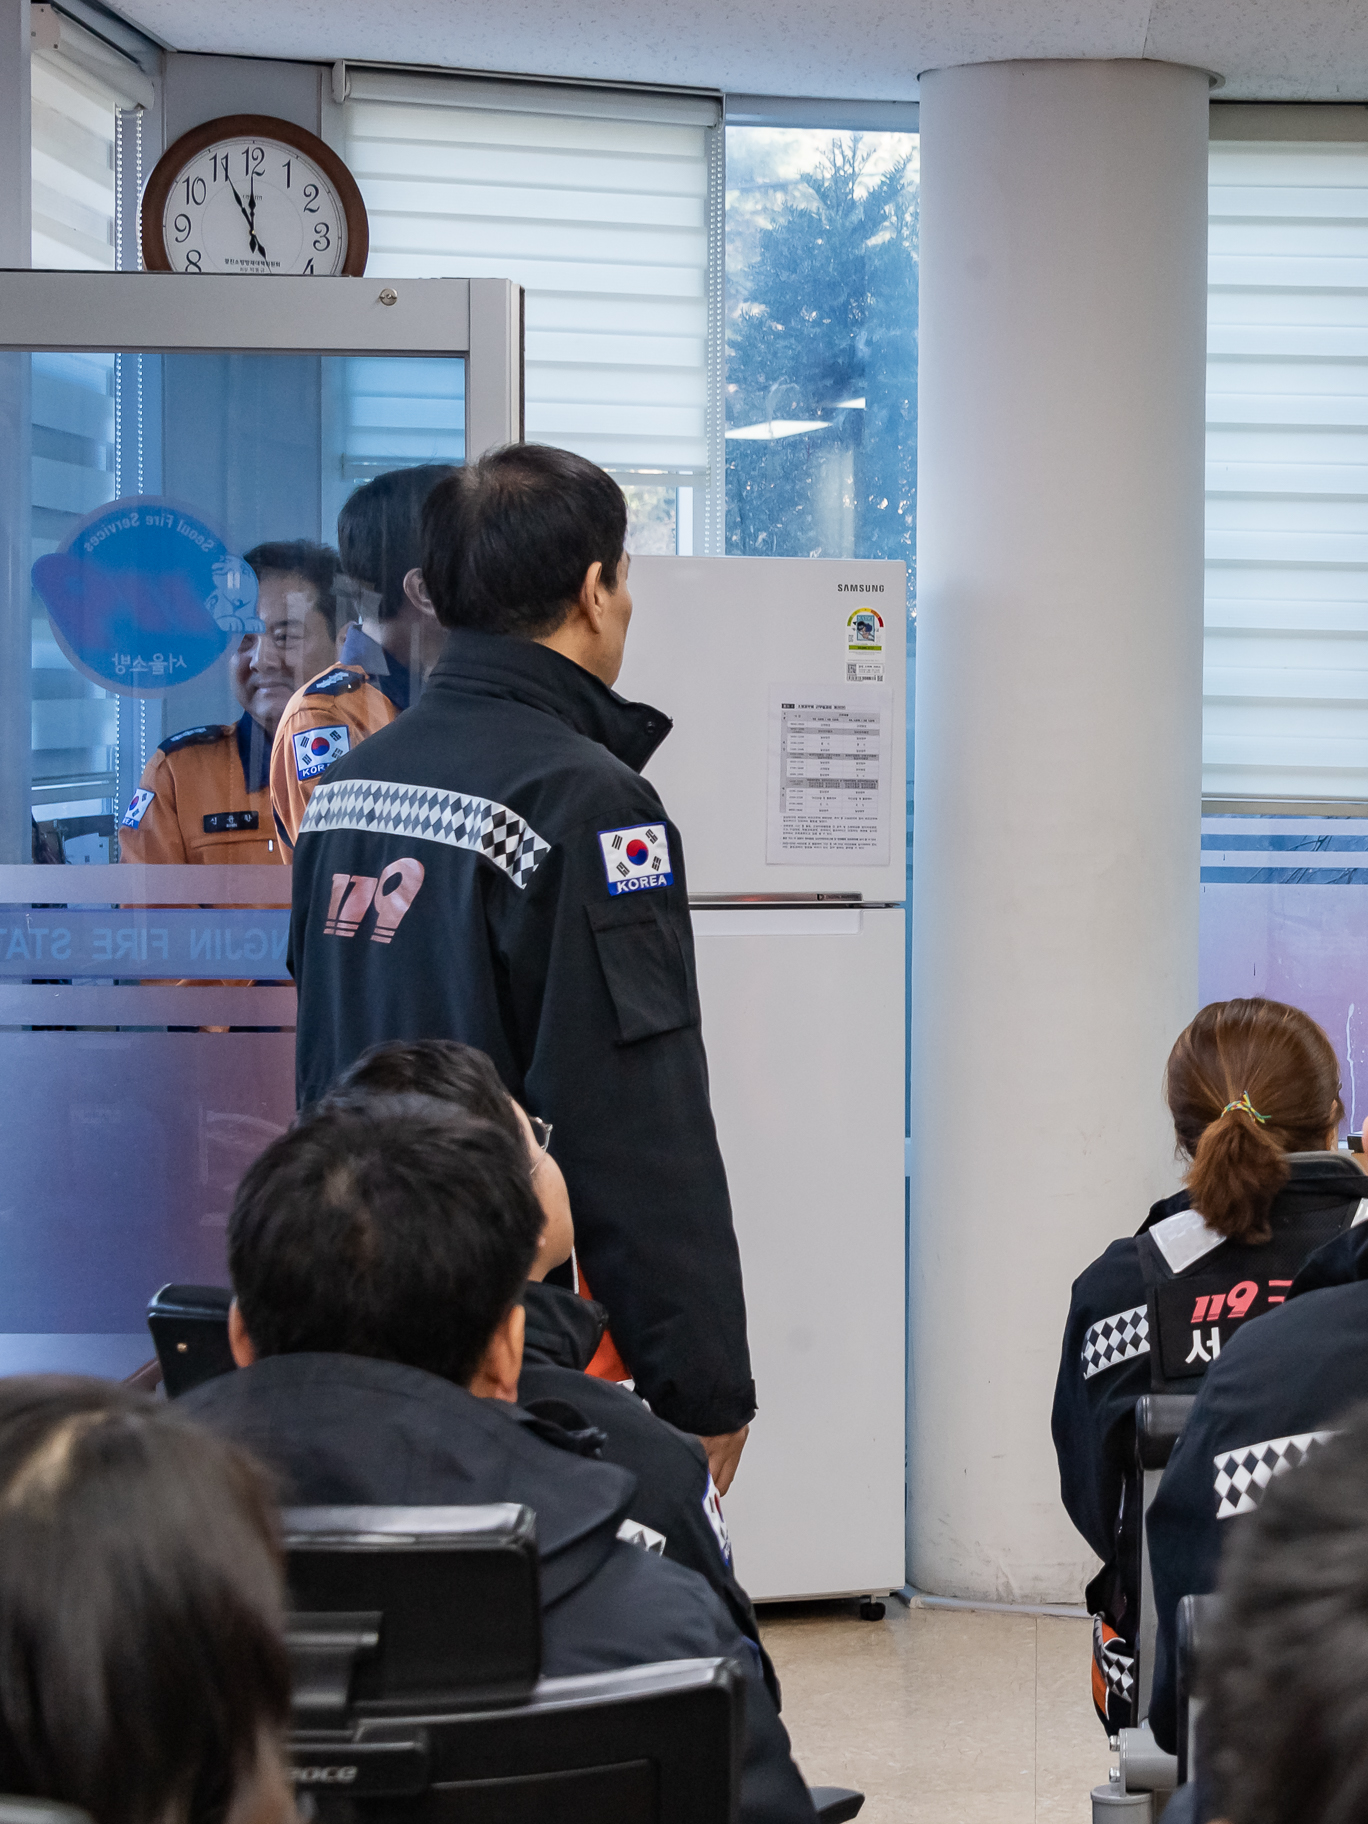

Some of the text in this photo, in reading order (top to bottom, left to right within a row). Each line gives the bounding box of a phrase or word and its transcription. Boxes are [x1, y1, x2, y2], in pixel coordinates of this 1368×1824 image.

[209, 152, 230, 182] 11
[242, 146, 266, 176] 12
[282, 159, 291, 189] 1
[182, 176, 206, 206] 10
[303, 184, 320, 214] 2
[174, 214, 192, 243] 9
[312, 222, 330, 252] 3
[186, 250, 202, 272] 8
[837, 583, 885, 593] SAMSUNG
[302, 764, 330, 777] KOR
[616, 875, 668, 894] KOREA
[323, 857, 425, 944] 119
[1190, 1280, 1259, 1324] 119
